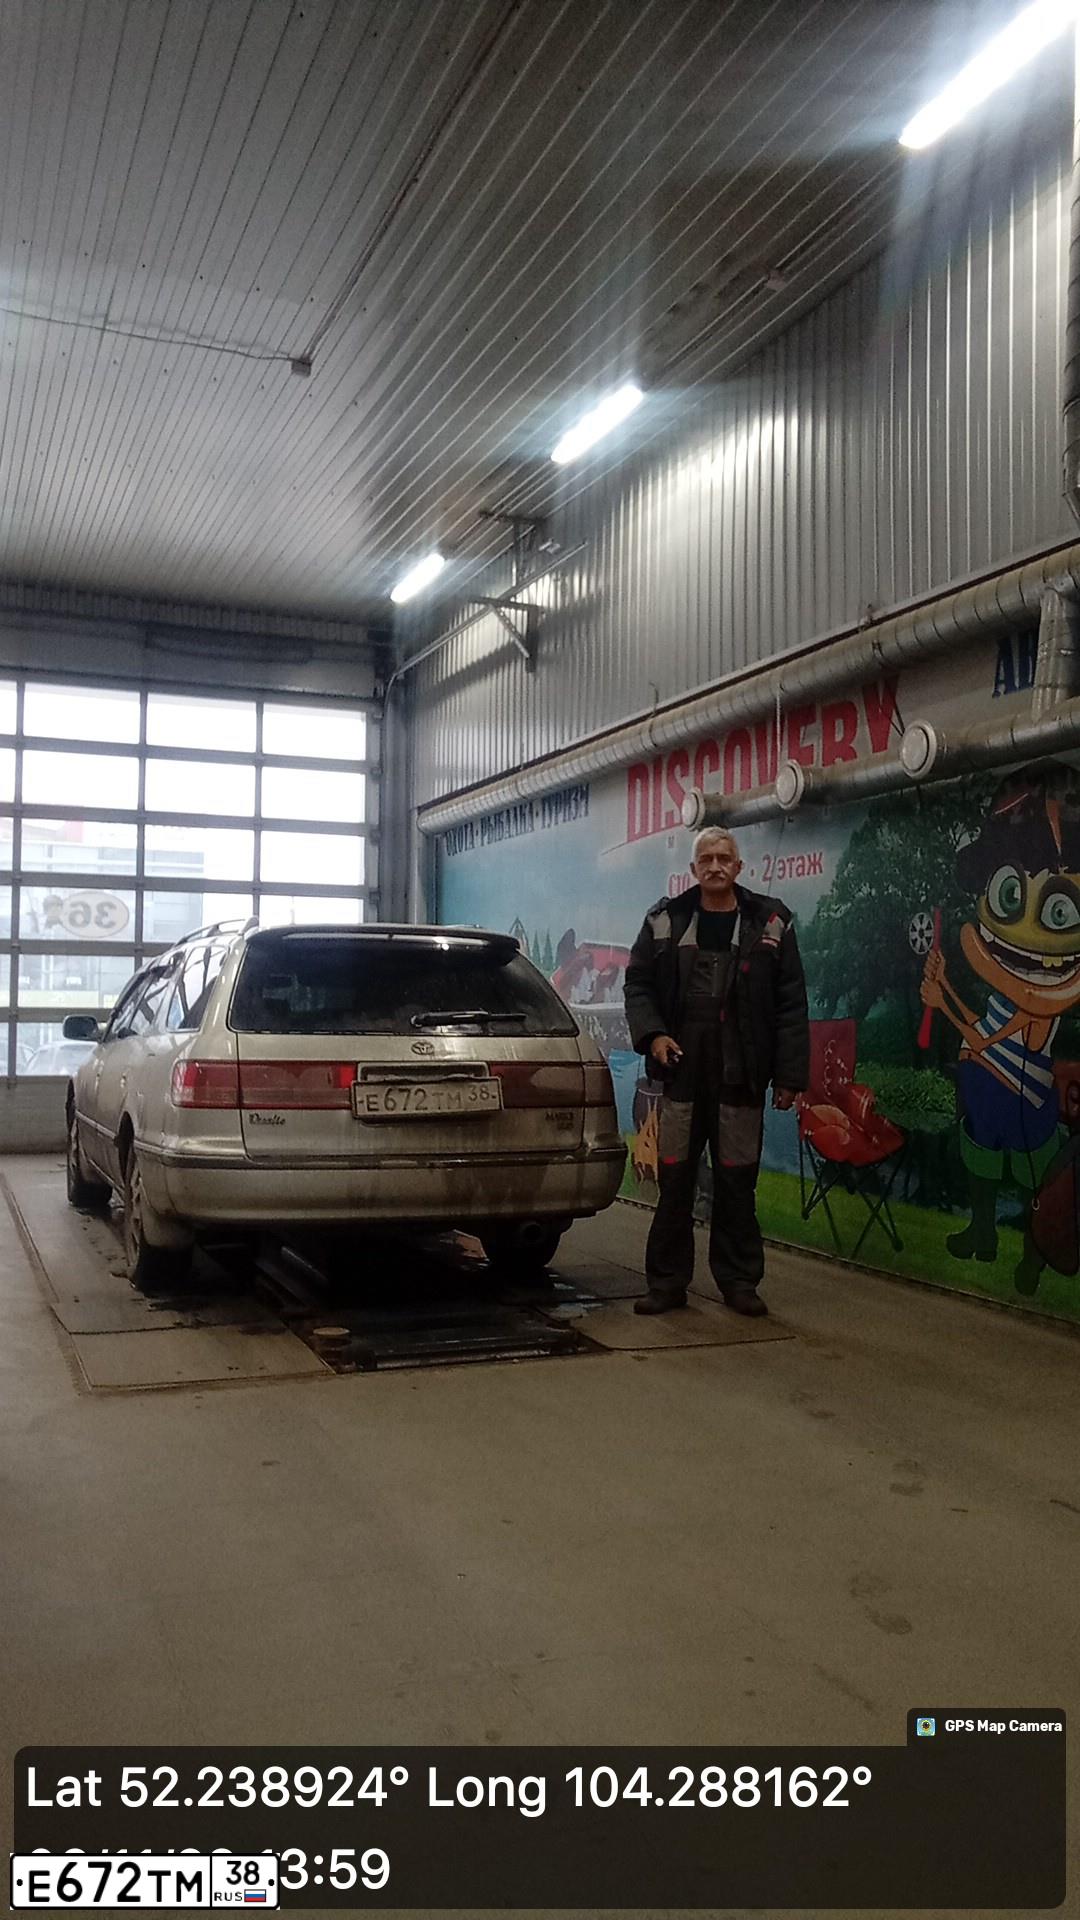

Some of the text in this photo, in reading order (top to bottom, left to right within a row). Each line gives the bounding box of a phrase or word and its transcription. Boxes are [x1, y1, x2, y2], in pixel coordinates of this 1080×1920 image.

[627, 675, 901, 843] DISCOVERY
[776, 851, 824, 881] этаж
[468, 1084, 490, 1102] 38
